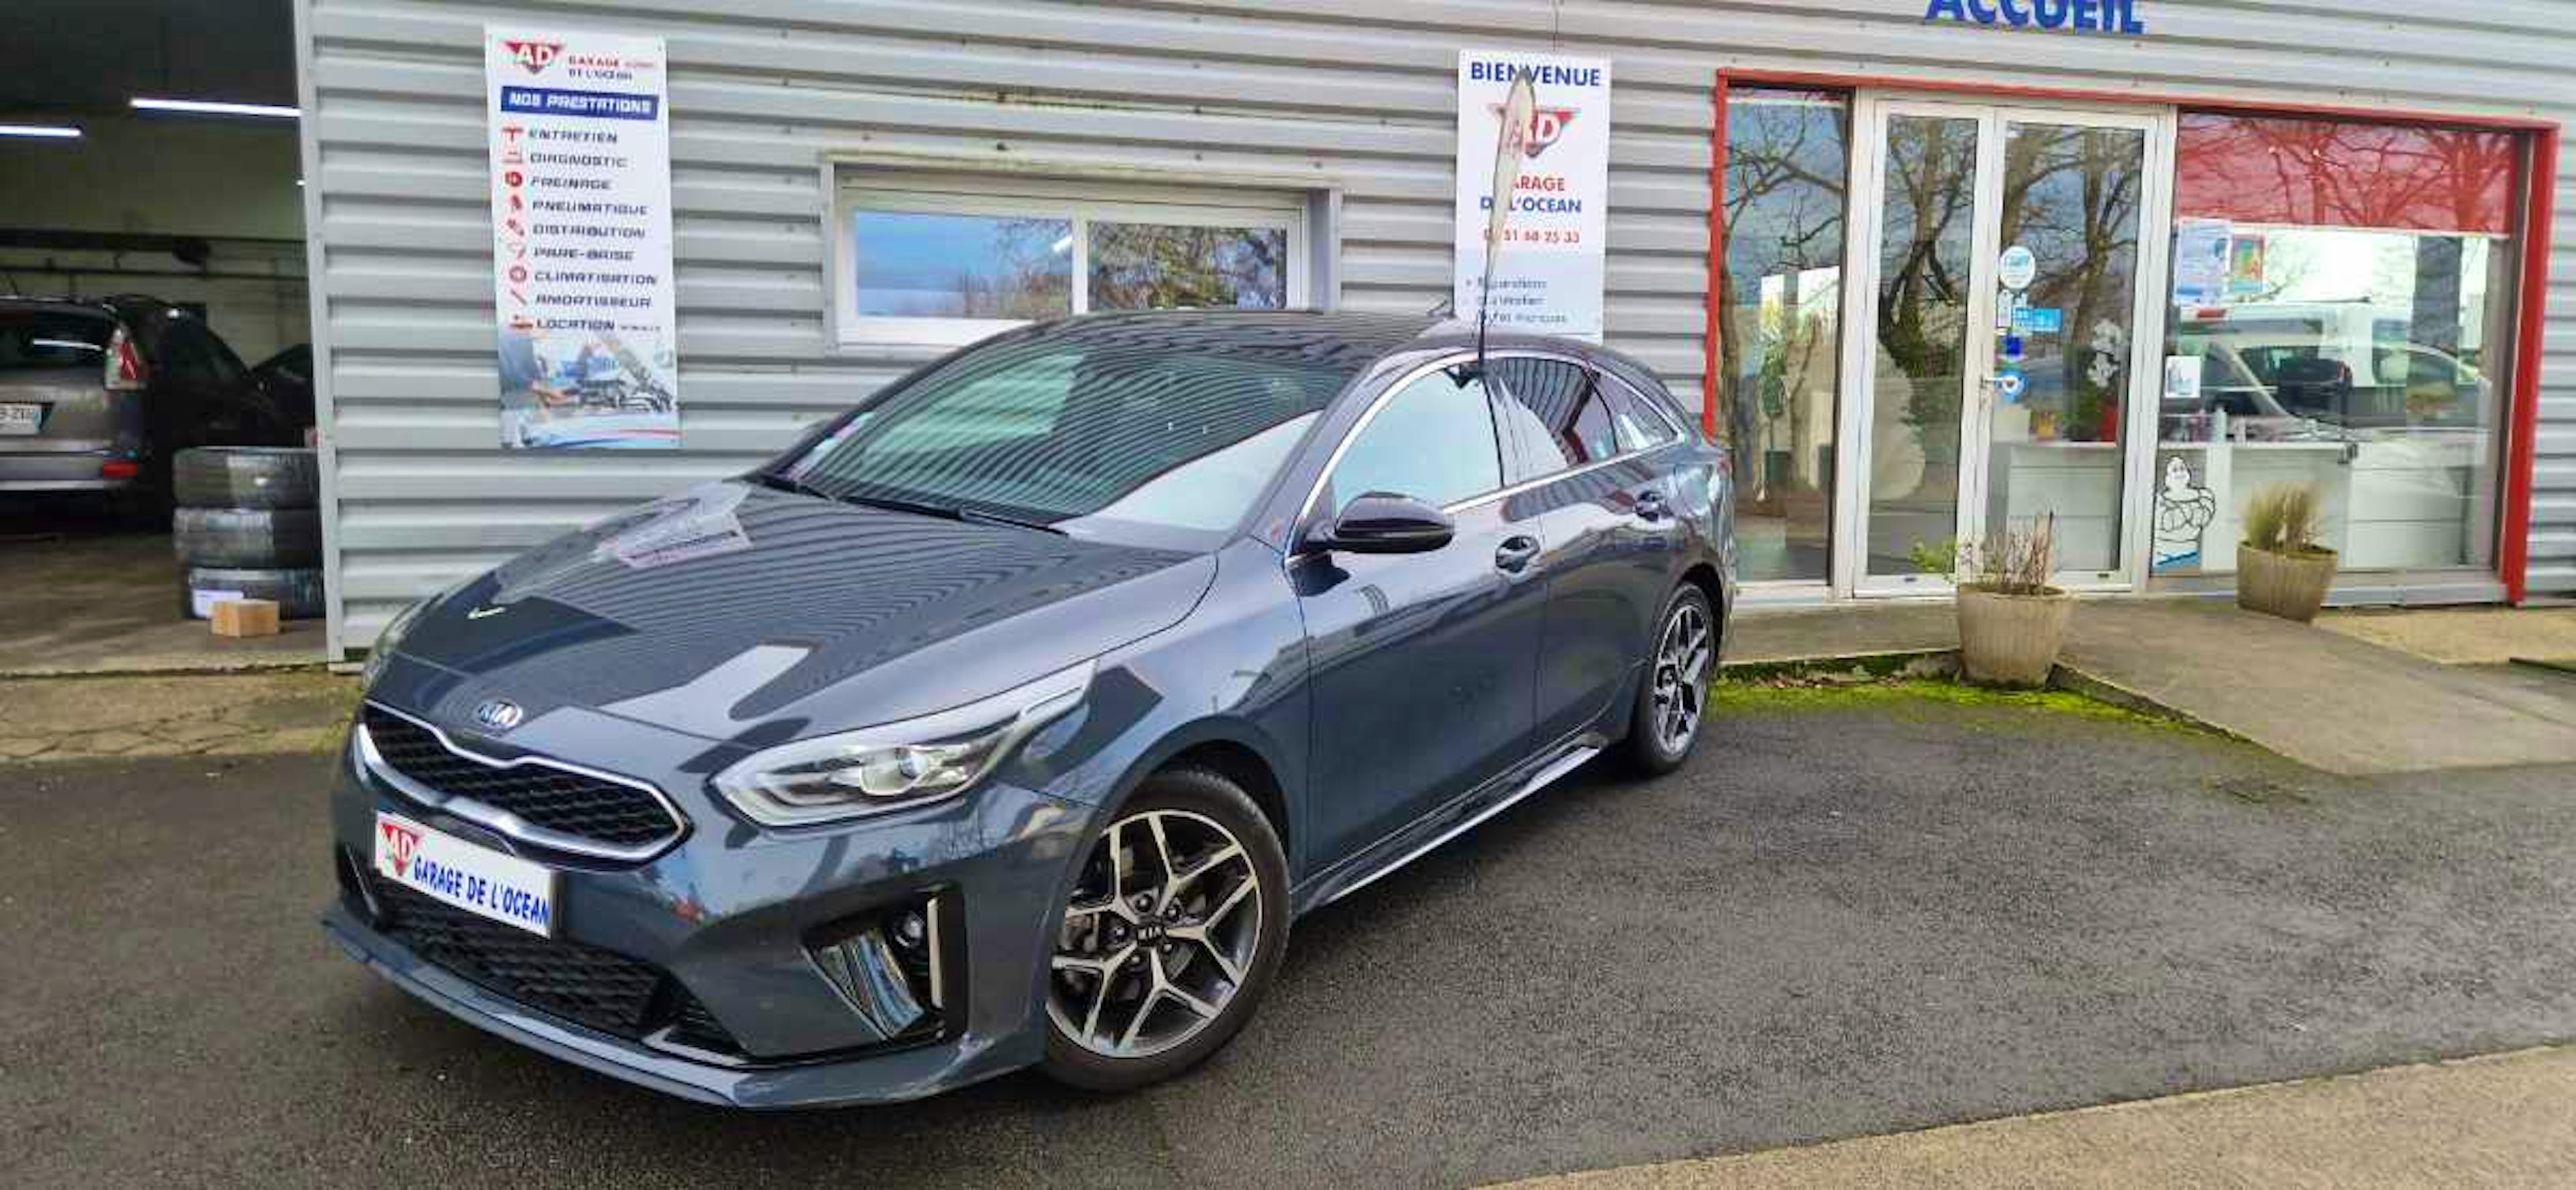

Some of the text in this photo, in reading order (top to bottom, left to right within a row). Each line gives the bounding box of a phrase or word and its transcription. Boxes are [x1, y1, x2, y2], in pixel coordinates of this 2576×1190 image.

[515, 43, 554, 66] AD
[508, 92, 652, 114] NOS PRESTATIONS
[529, 129, 618, 144] ENTRETIEN
[530, 154, 629, 168] DIAGNOSTIC
[531, 176, 611, 190] FREINAGE
[532, 200, 649, 215] PNEUMATIQUE
[533, 223, 646, 239] DISTRIBUTION
[534, 248, 636, 261] PARE-BRISE
[534, 270, 657, 285] CLIMATISATION
[536, 294, 652, 309] AMORTISSEUR
[537, 319, 615, 331] LOCATION
[390, 825, 415, 861] AD
[414, 855, 551, 924] GARAGE DE L'OCEAN
